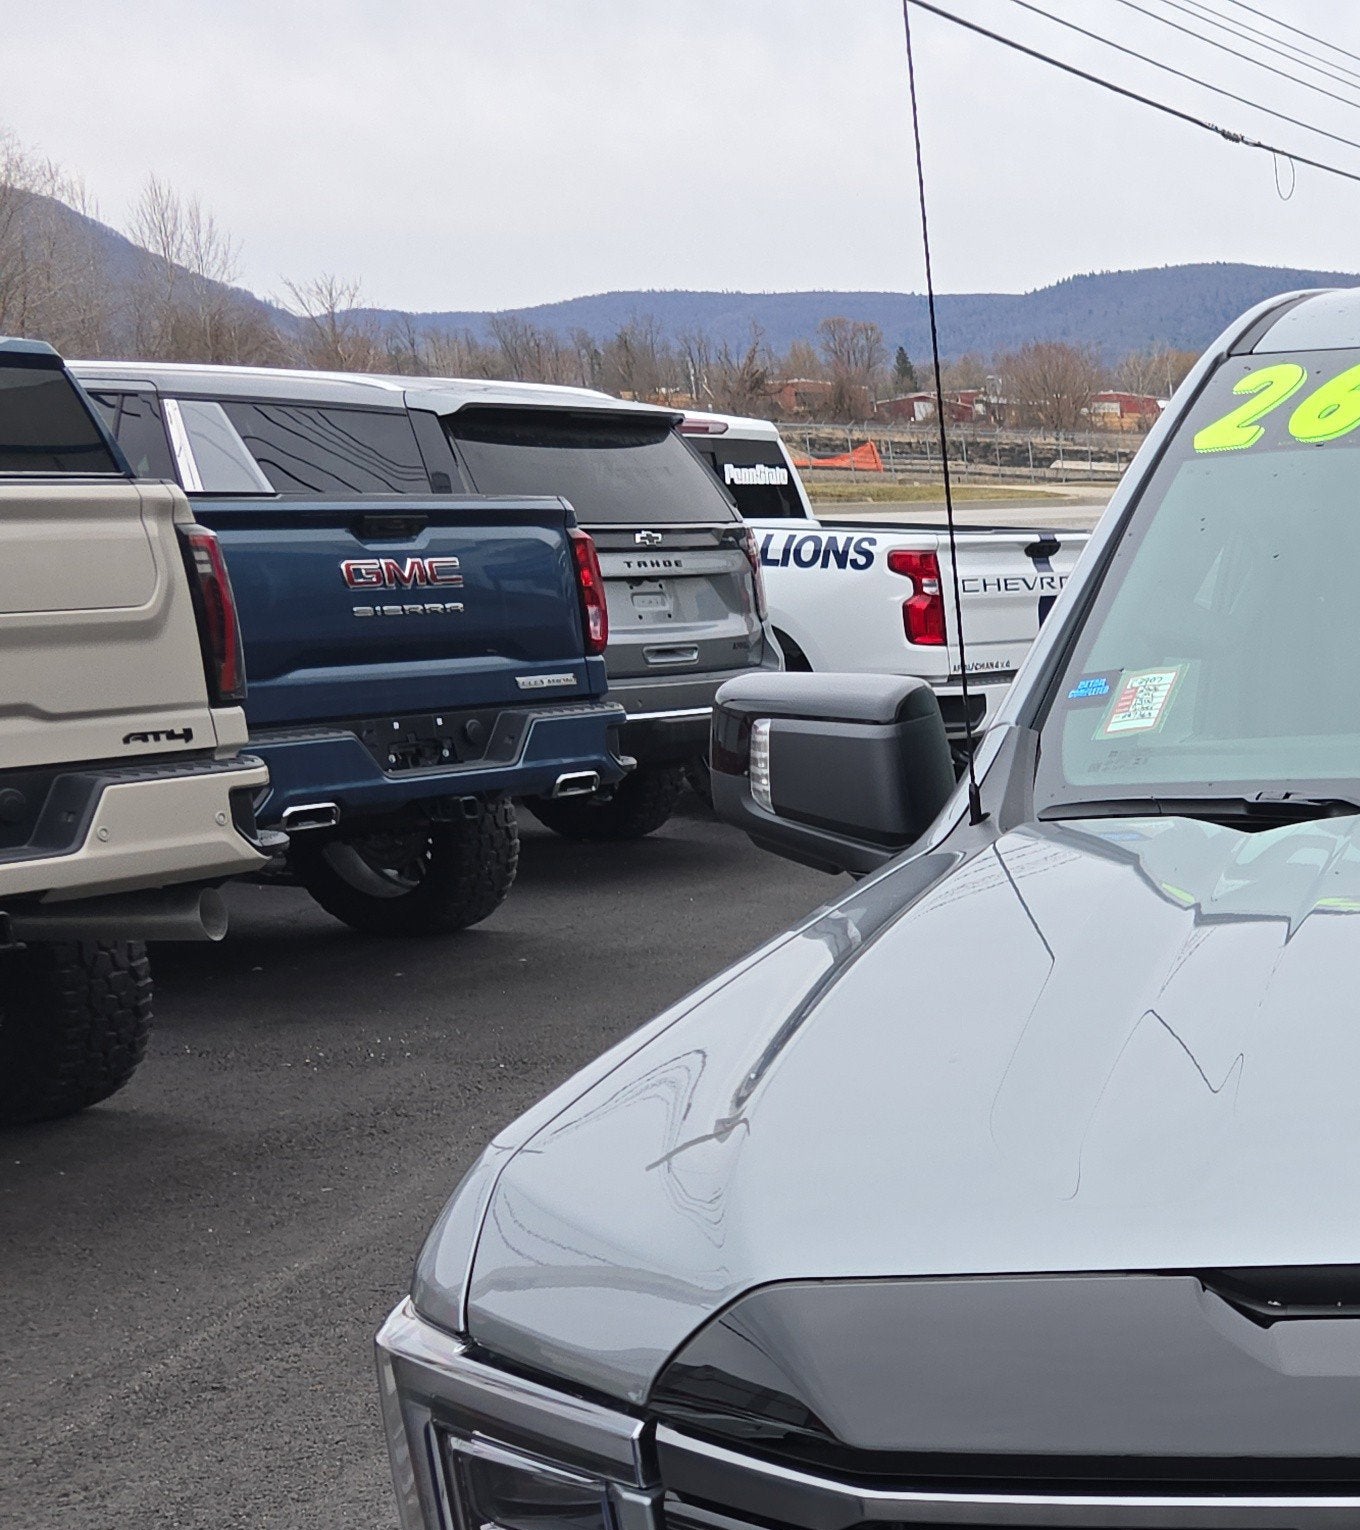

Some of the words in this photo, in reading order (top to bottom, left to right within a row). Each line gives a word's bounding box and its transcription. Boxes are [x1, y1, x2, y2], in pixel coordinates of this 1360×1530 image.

[761, 533, 878, 570] LIONS
[623, 559, 683, 569] TAHOE
[341, 557, 464, 588] GMC
[352, 602, 464, 617] SIERRA
[122, 728, 193, 744] AT4
